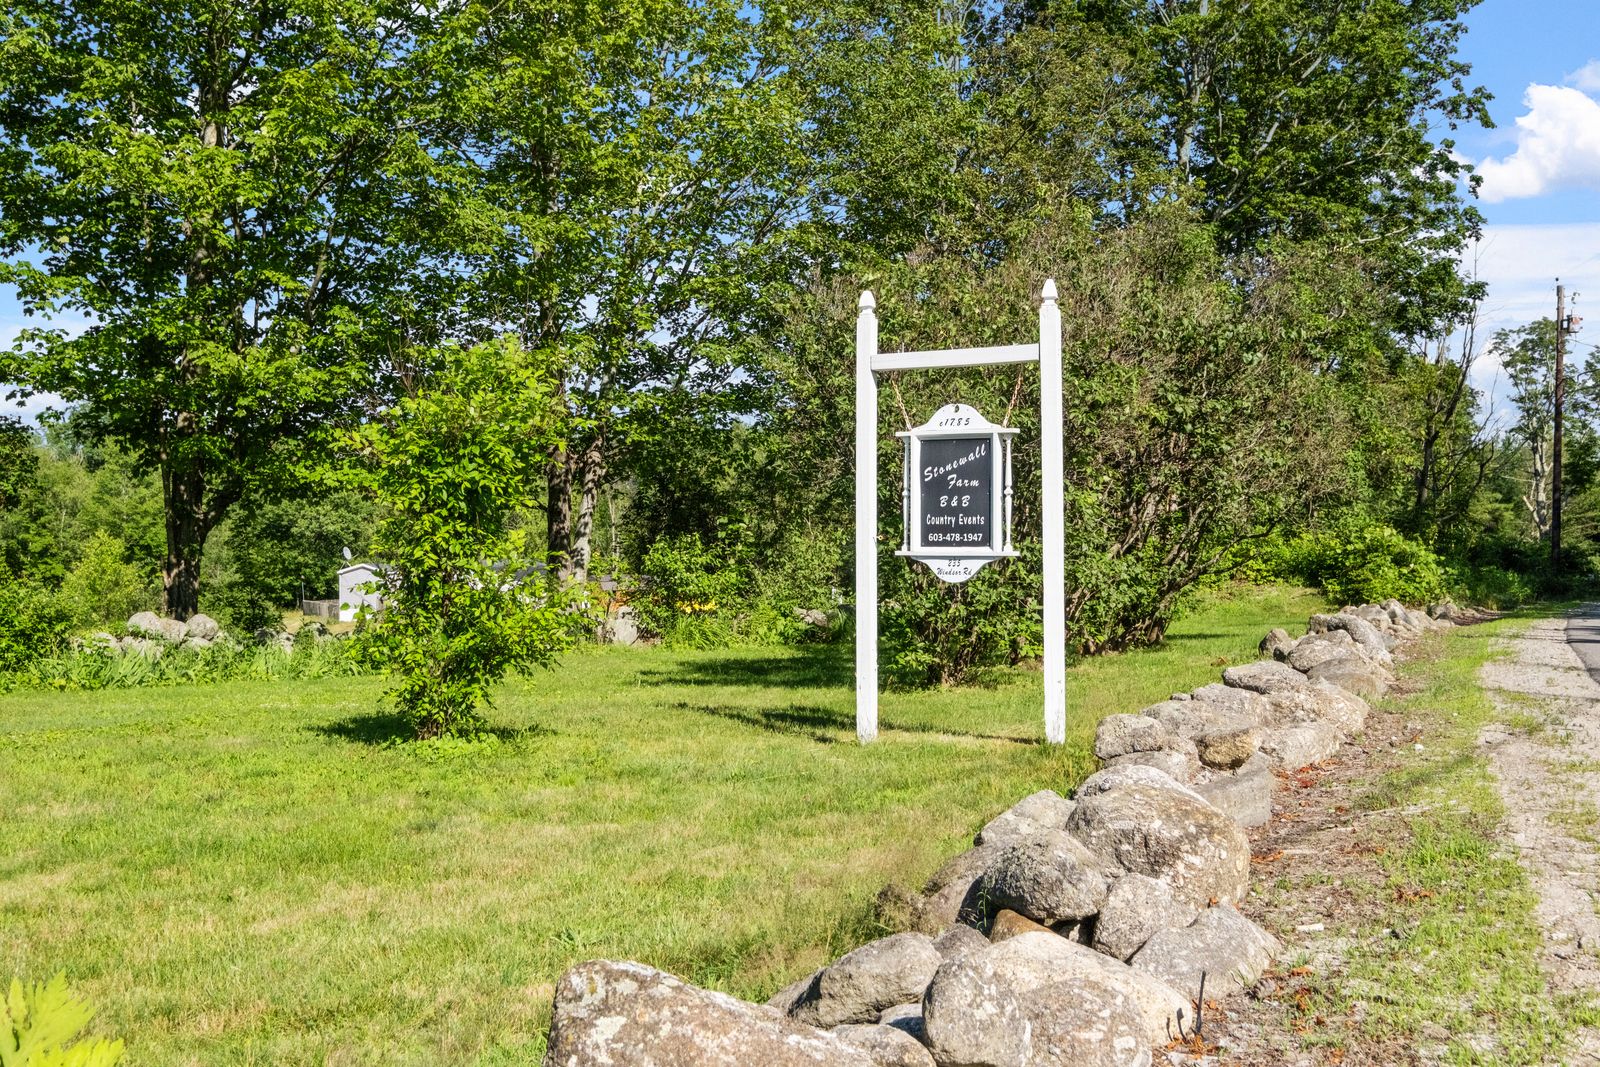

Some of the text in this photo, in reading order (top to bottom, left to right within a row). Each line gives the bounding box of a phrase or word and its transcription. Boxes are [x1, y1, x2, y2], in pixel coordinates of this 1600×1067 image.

[924, 443, 986, 482] Stonewall
[947, 474, 980, 489] Farm
[940, 495, 971, 507] B & B
[926, 513, 985, 528] Country Events
[928, 533, 983, 542] 603-478-1947
[947, 559, 961, 567] 235
[936, 567, 973, 576] Windsor Rd
